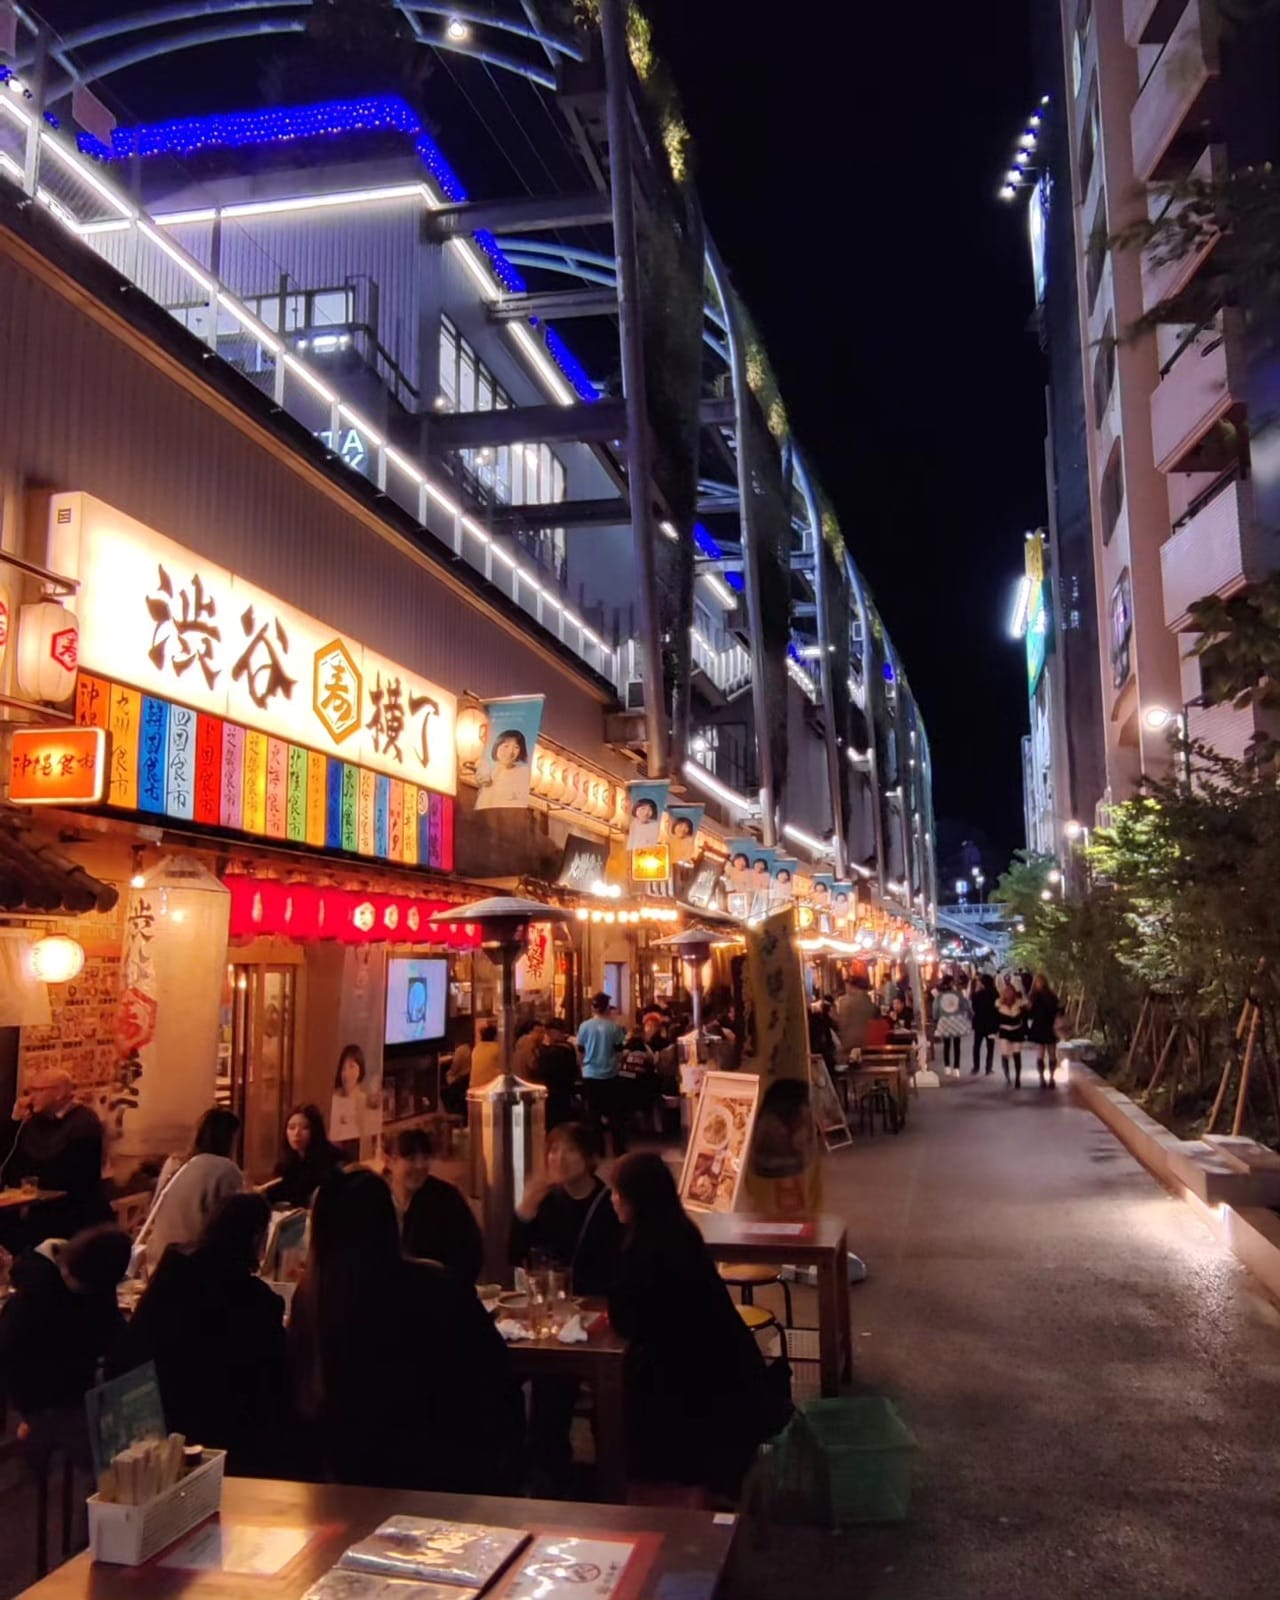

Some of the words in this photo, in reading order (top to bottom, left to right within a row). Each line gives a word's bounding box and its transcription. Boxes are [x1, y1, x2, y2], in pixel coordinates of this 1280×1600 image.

[146, 563, 298, 710] 渋谷
[167, 711, 192, 808] 四国食市
